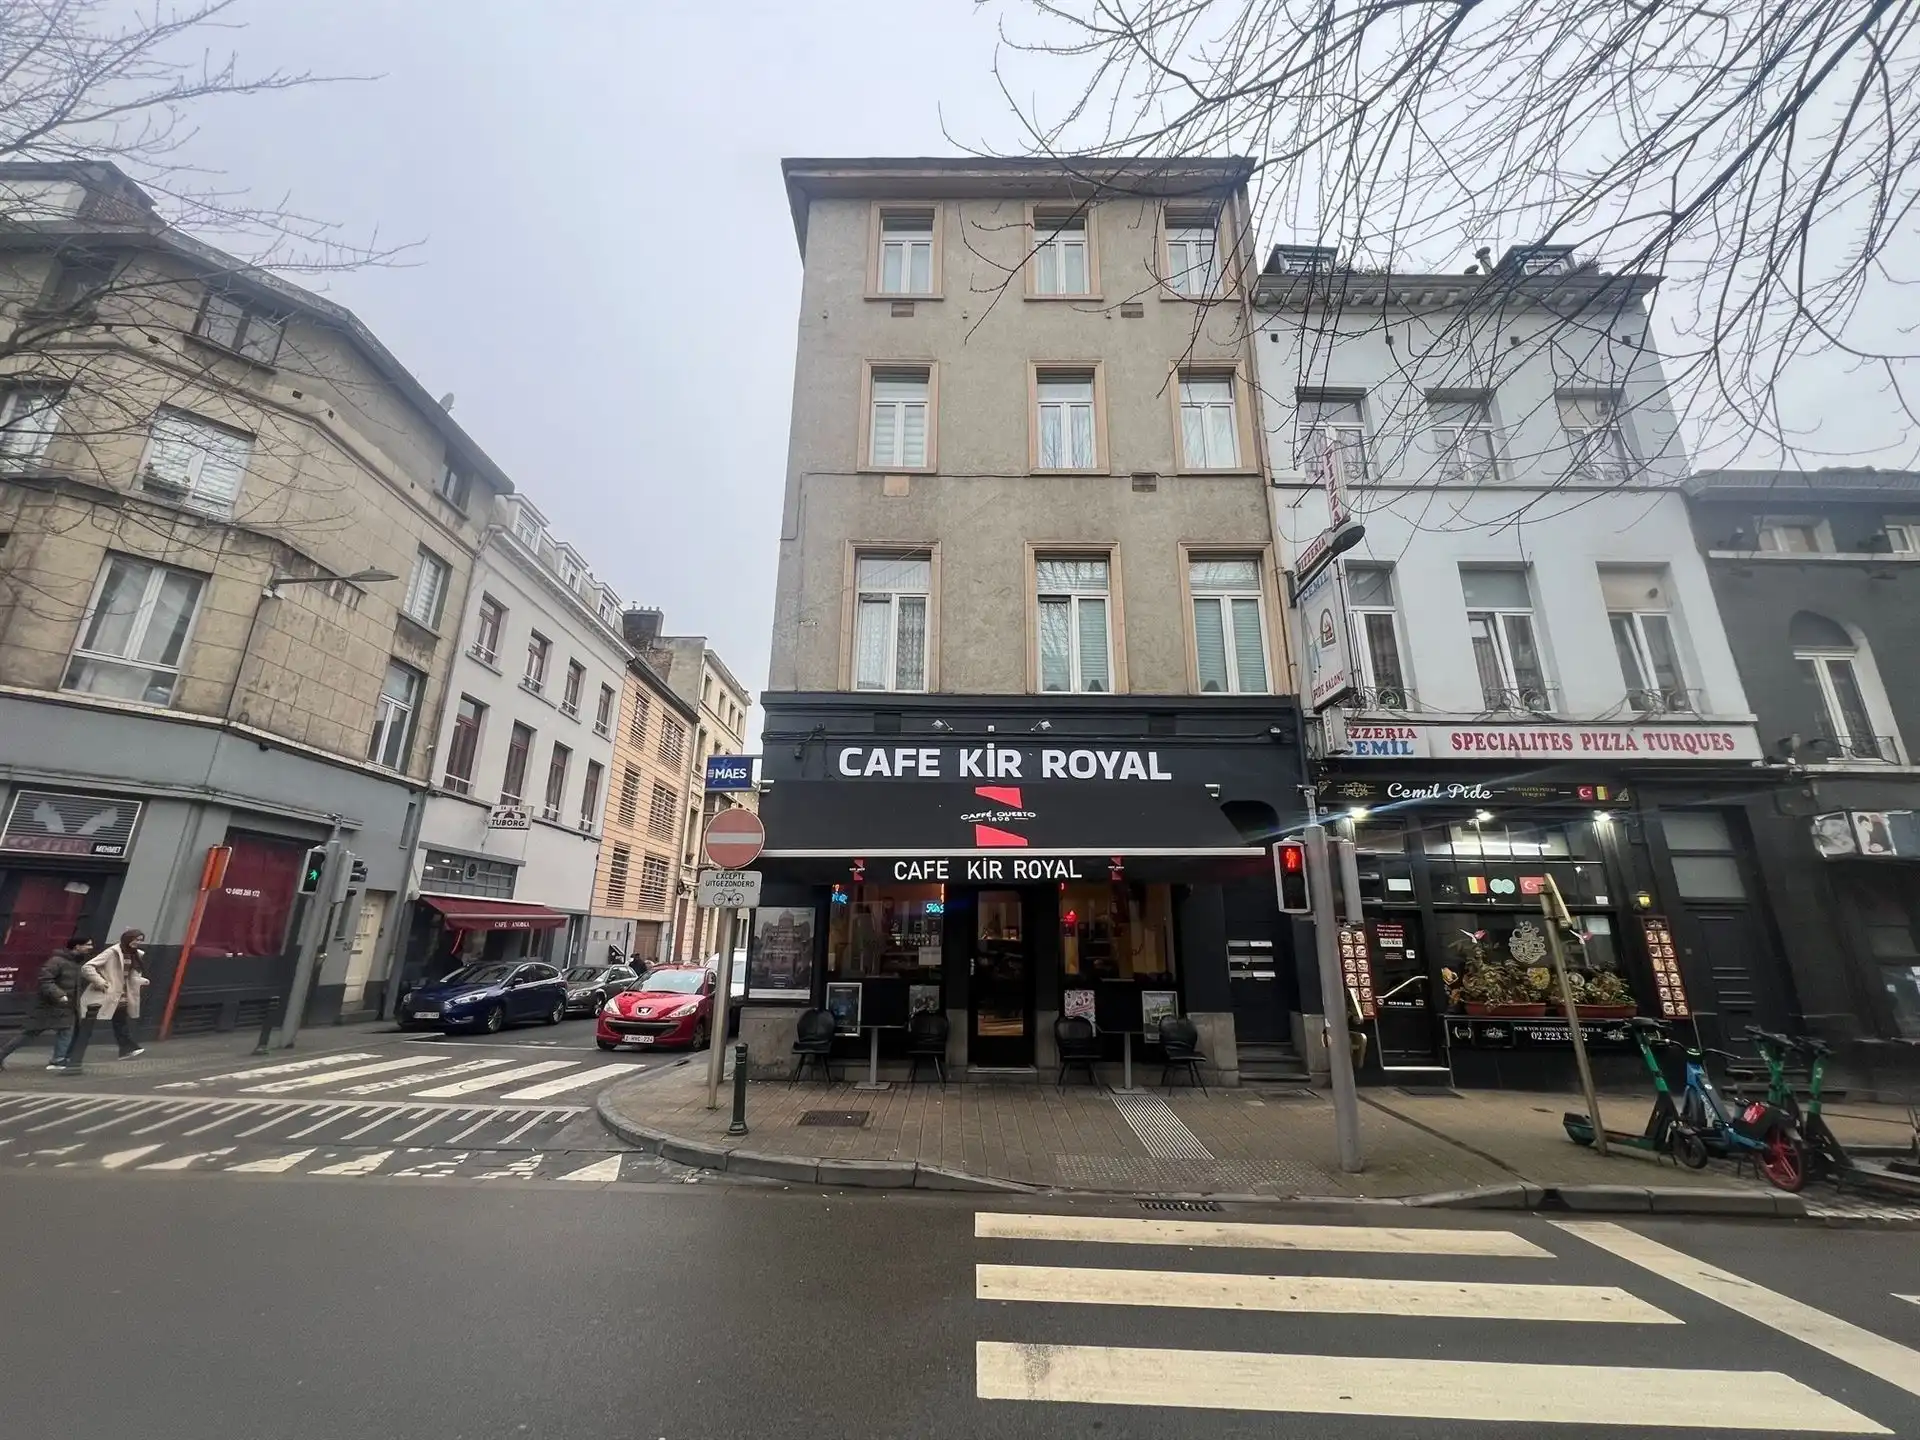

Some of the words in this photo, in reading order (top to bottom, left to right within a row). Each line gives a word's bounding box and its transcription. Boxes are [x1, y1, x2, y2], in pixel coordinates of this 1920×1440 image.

[1324, 451, 1342, 524] PIZZA
[1451, 732, 1573, 751] SPECIALITES
[1580, 733, 1639, 751] PIZZA
[1643, 733, 1735, 754] TURQUES
[714, 768, 747, 779] MAES
[839, 747, 941, 778] CAFE
[1042, 751, 1172, 781] ROYAL
[1387, 783, 1441, 799] Cemil
[1447, 783, 1493, 800] Pide
[491, 819, 525, 827] TUBORG
[1014, 859, 1082, 879] ROYAL
